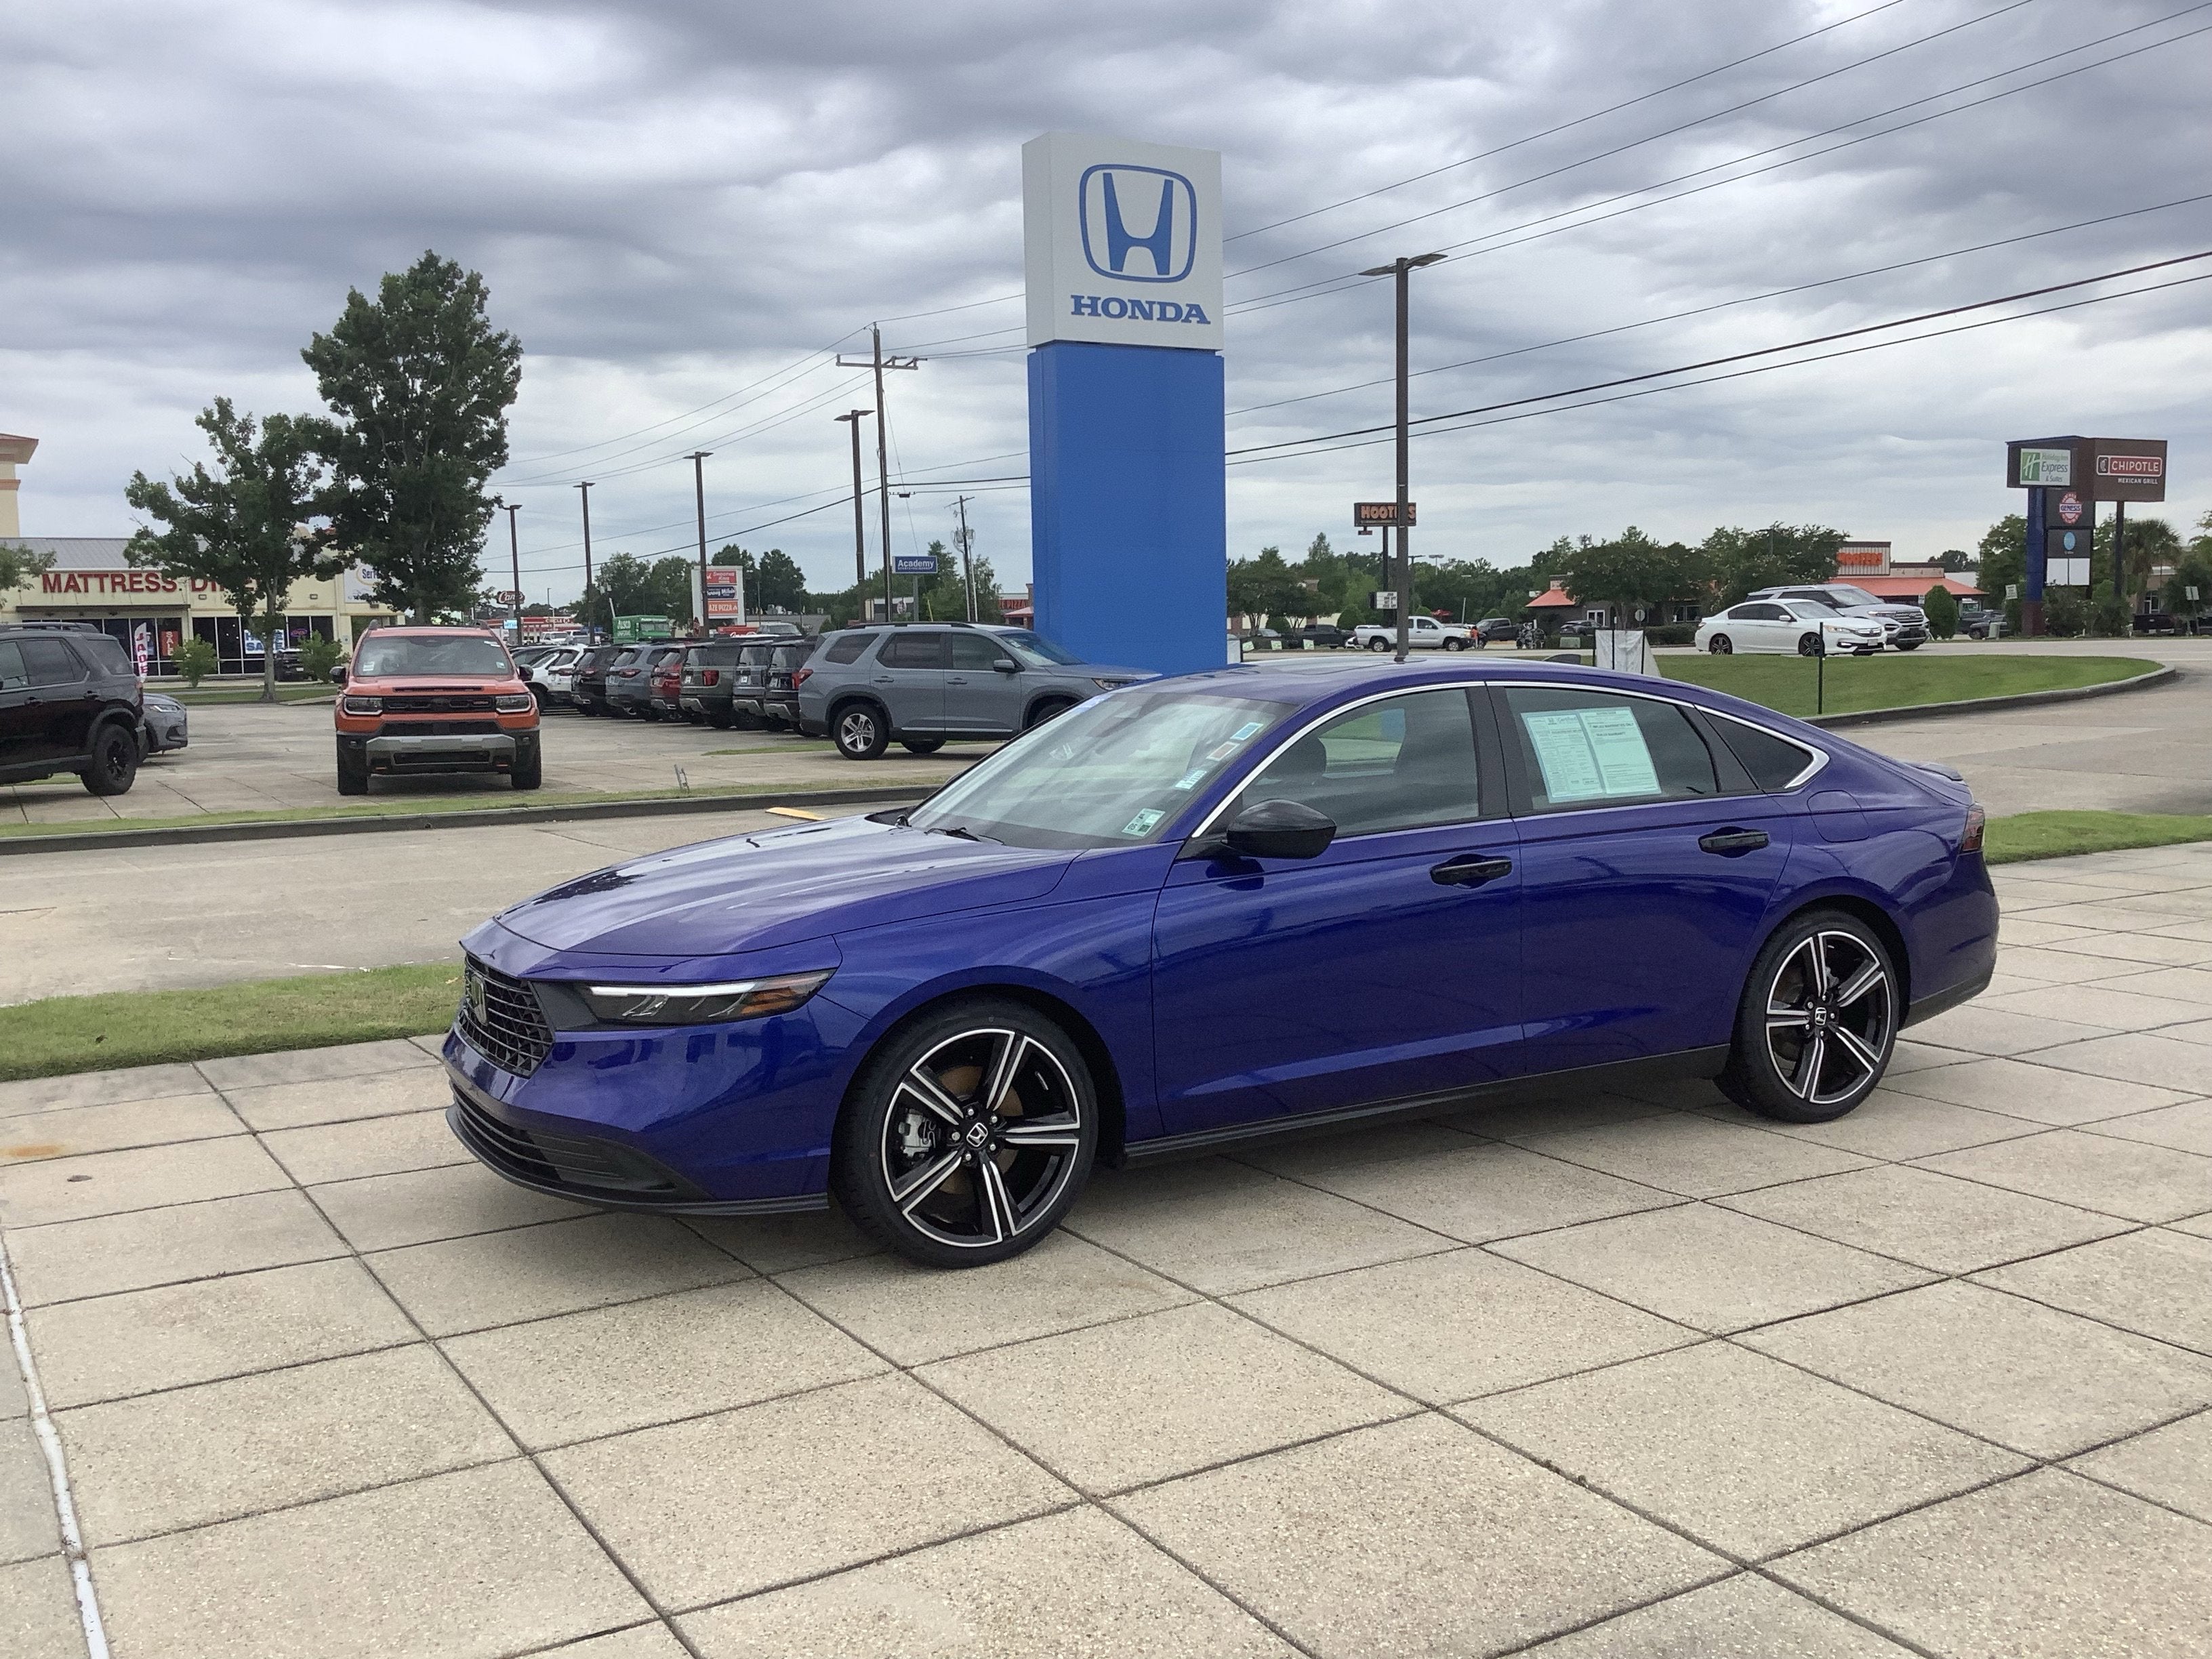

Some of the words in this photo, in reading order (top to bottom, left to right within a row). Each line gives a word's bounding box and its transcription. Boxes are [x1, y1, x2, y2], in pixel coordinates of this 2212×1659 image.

[1071, 294, 1211, 324] HONDA
[2041, 462, 2068, 474] Express
[2112, 461, 2158, 472] CHIPOTLE
[1361, 505, 1416, 519] HOOTS
[898, 560, 935, 569] Academy
[42, 572, 178, 593] MATTRESS
[165, 631, 174, 656] SALE
[245, 641, 283, 651] SAE
